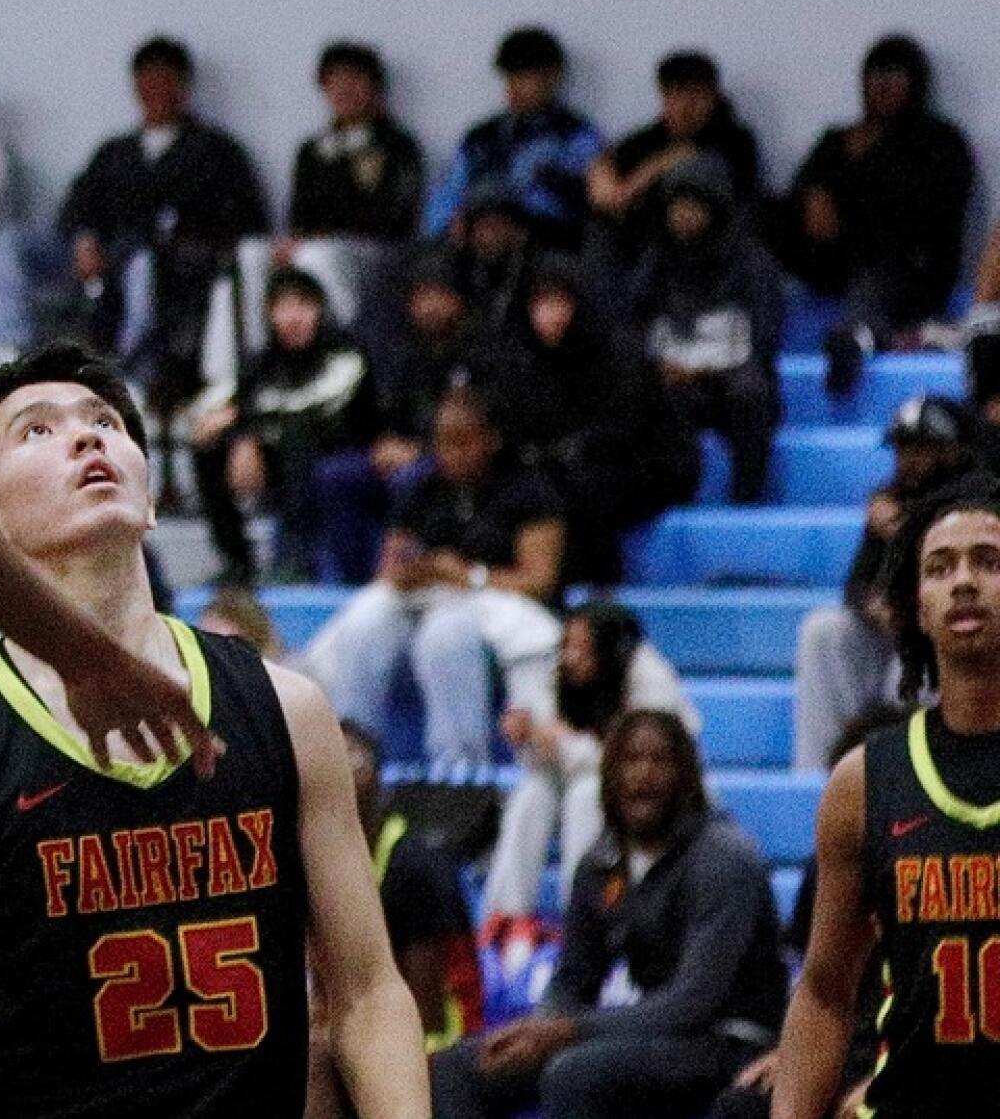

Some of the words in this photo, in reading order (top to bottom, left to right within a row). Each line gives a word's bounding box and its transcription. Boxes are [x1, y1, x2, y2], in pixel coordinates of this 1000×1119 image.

[37, 807, 278, 918] FAIRFAX
[895, 855, 1000, 923] FAIR
[88, 915, 269, 1064] 25
